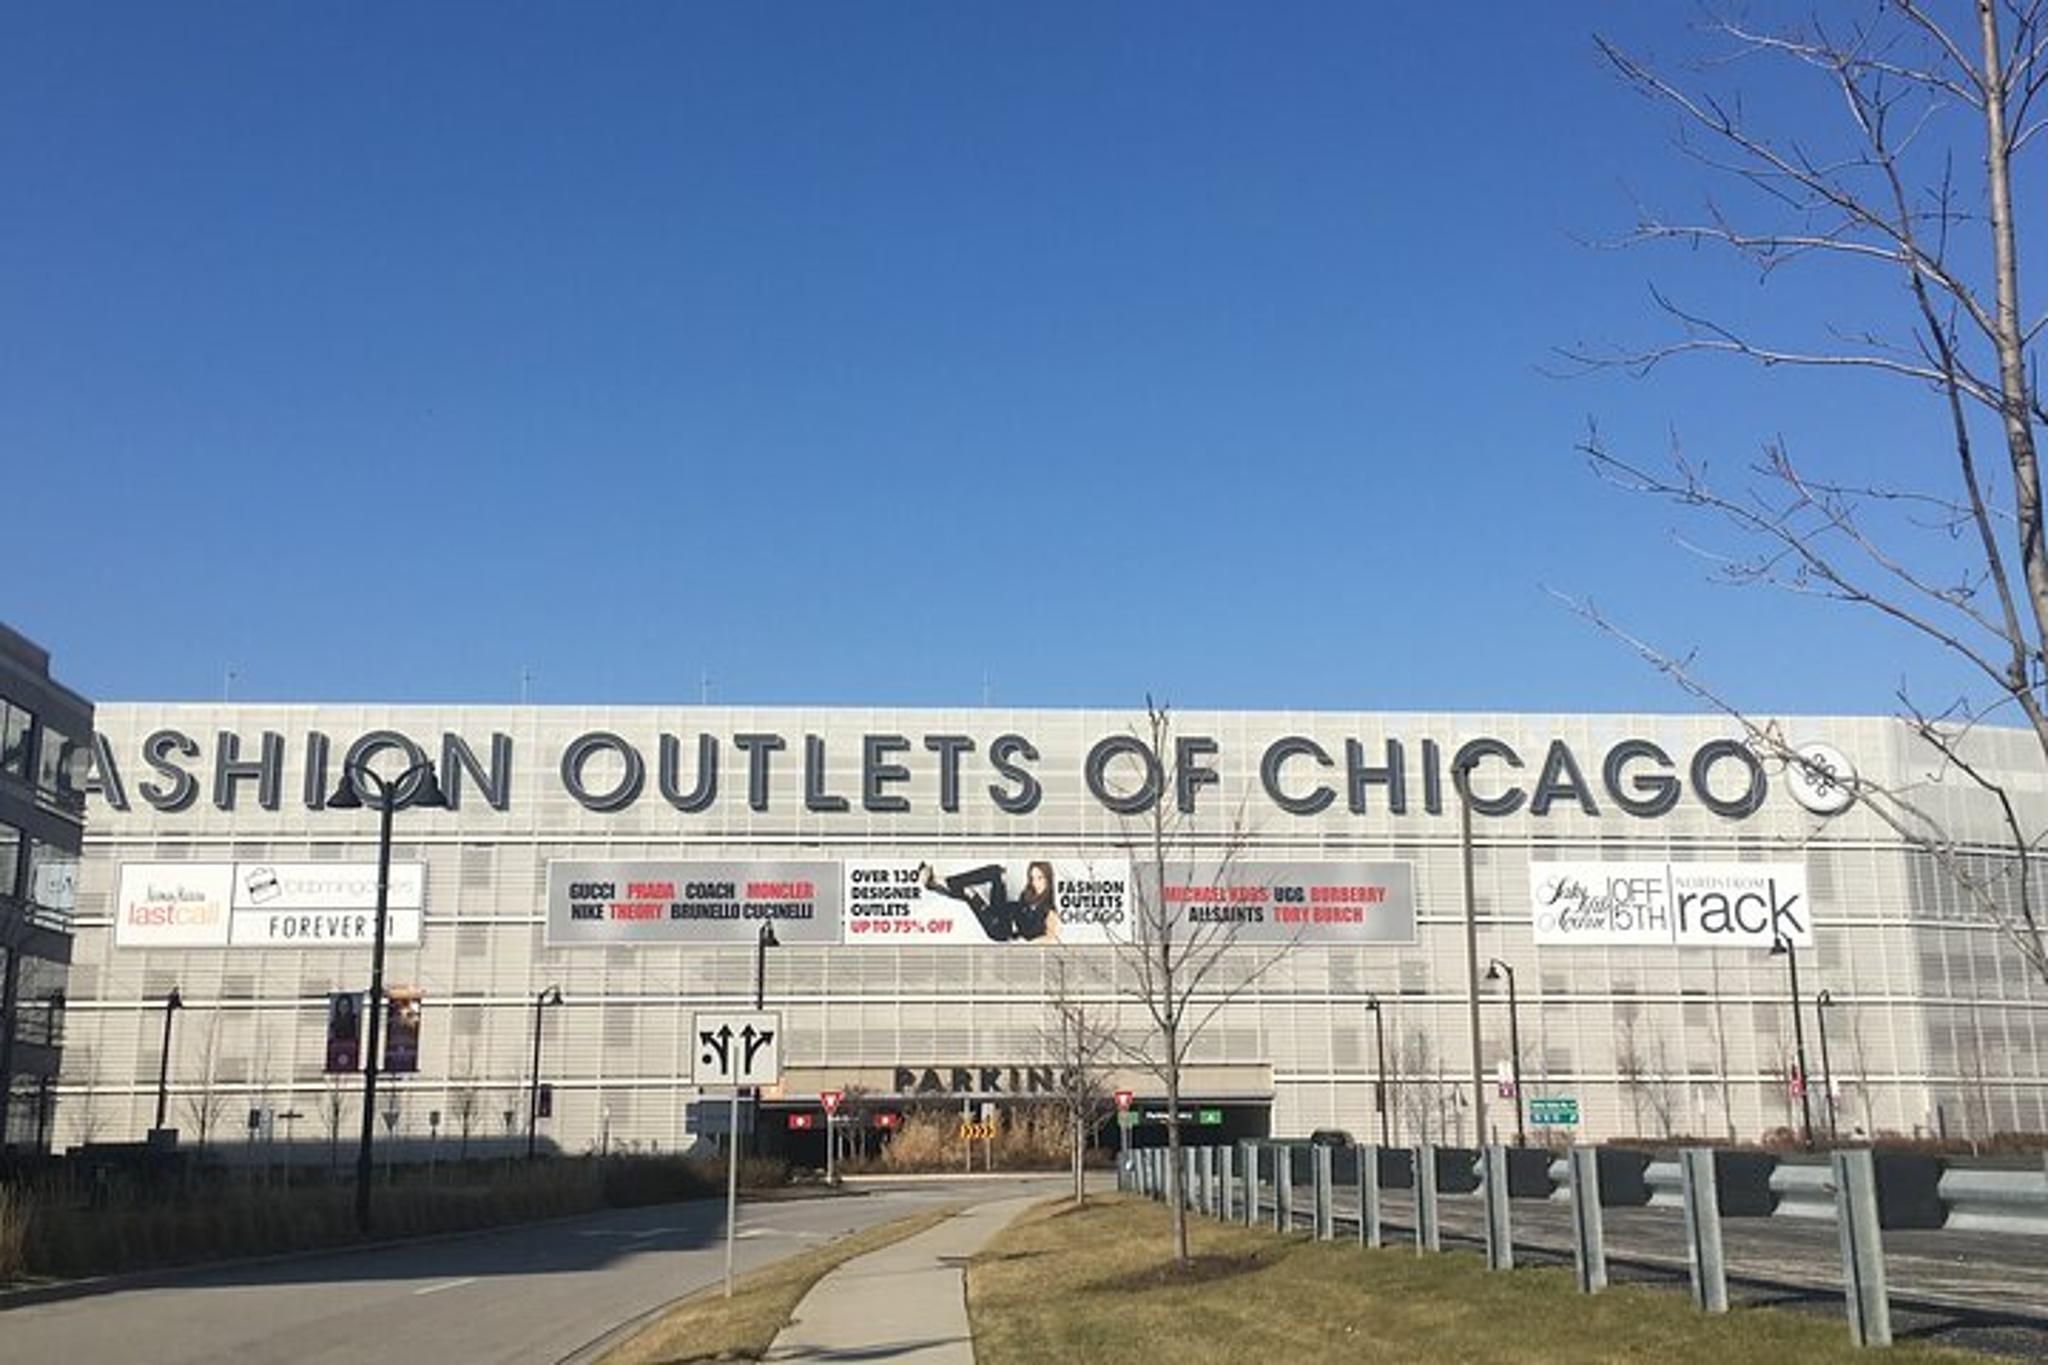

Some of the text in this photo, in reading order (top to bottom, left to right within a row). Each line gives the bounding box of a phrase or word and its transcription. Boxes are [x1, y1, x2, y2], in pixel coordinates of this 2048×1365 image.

[82, 730, 1769, 819] ASHION OUTLETS OF CHICAGO
[851, 869, 920, 883] OVER 130
[569, 882, 814, 900] GUCCI PRADA COACH MONCLER
[851, 886, 922, 900] DESIGNER
[1058, 881, 1125, 895] FASHION
[1164, 886, 1227, 903] MICHAEL
[1273, 886, 1306, 903] UGG
[1309, 886, 1386, 903] BURBERRY
[1612, 877, 1662, 905] OFF
[571, 903, 814, 920] NIKE THEORY BRUNELLO CUCINELLI
[851, 903, 911, 917] OUTLETS
[1060, 896, 1123, 910] OUTLETS
[1677, 877, 1805, 935] rack
[1060, 911, 1125, 925] CHICAGO
[1188, 906, 1364, 923] ALLSAINTS TORY BURCH
[1615, 904, 1667, 932] 5TH
[269, 915, 394, 938] FOREVER 1
[850, 920, 871, 934] UP
[872, 920, 891, 934] TO
[927, 920, 955, 934] OFF
